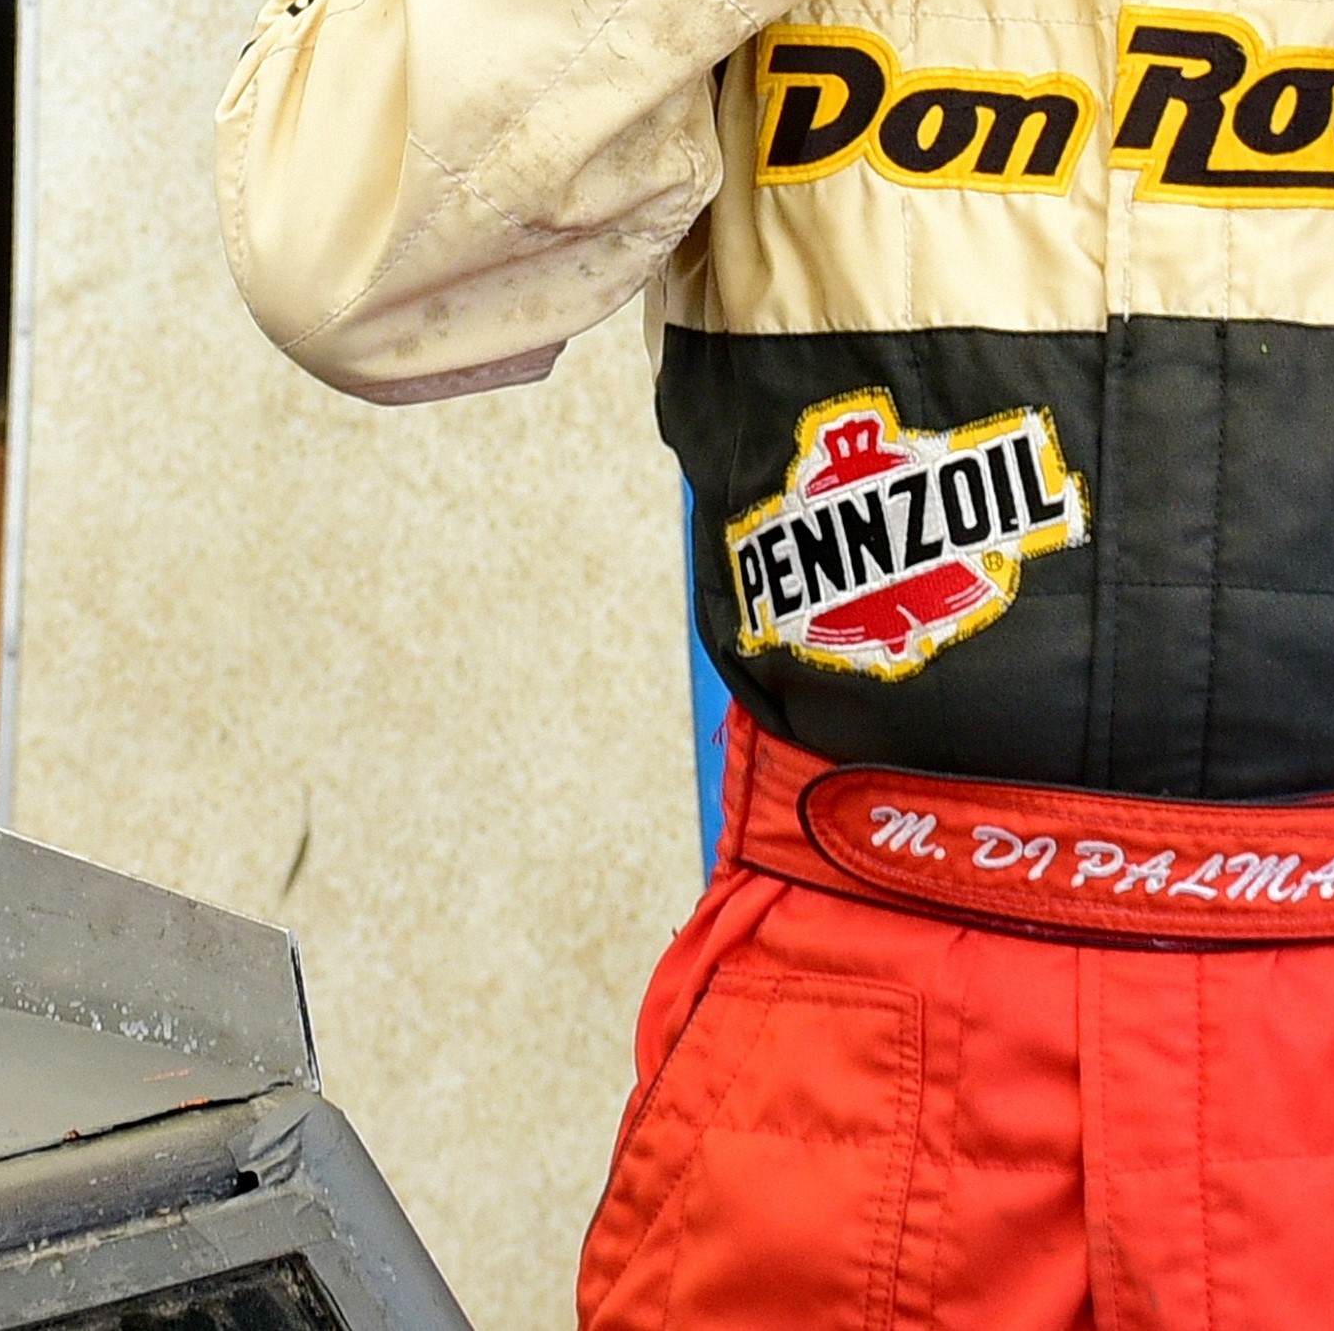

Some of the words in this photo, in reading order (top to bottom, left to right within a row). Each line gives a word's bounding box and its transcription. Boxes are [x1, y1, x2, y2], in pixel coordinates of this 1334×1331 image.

[767, 44, 1079, 176] Don
[738, 437, 1067, 632] PENNZOIL
[870, 806, 946, 861] M.
